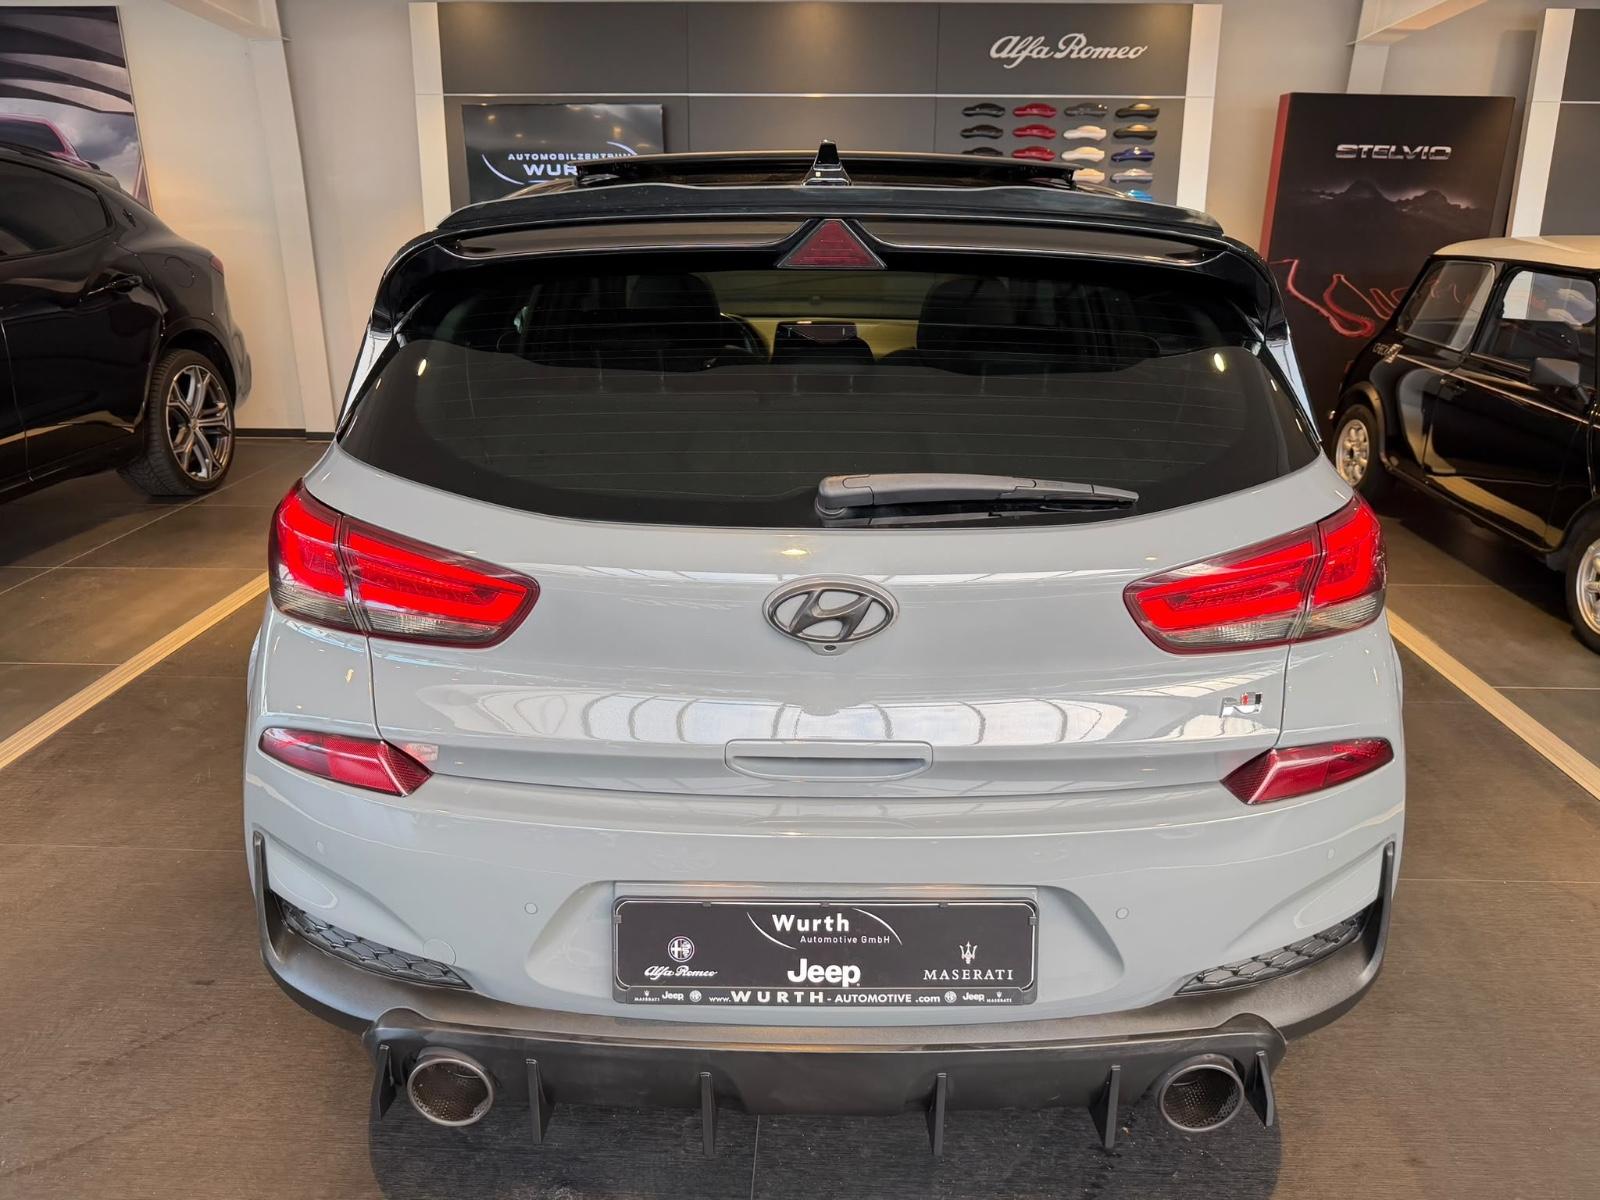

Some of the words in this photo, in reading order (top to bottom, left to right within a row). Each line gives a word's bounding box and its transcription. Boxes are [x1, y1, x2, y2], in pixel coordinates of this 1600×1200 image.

[990, 35, 1054, 69] Alfa
[1053, 33, 1148, 59] Romeo
[1335, 144, 1452, 160] STELVIO
[523, 163, 578, 176] WUR
[772, 912, 850, 932] Wurth
[800, 935, 858, 944] Automotive
[861, 935, 890, 944] GmbH
[644, 965, 674, 981] Alfa
[674, 965, 718, 978] Romeo
[787, 958, 861, 988] Jeep
[923, 969, 1014, 980] MASERATI
[662, 991, 684, 1001] Jeep
[962, 992, 985, 1002] Jeep
